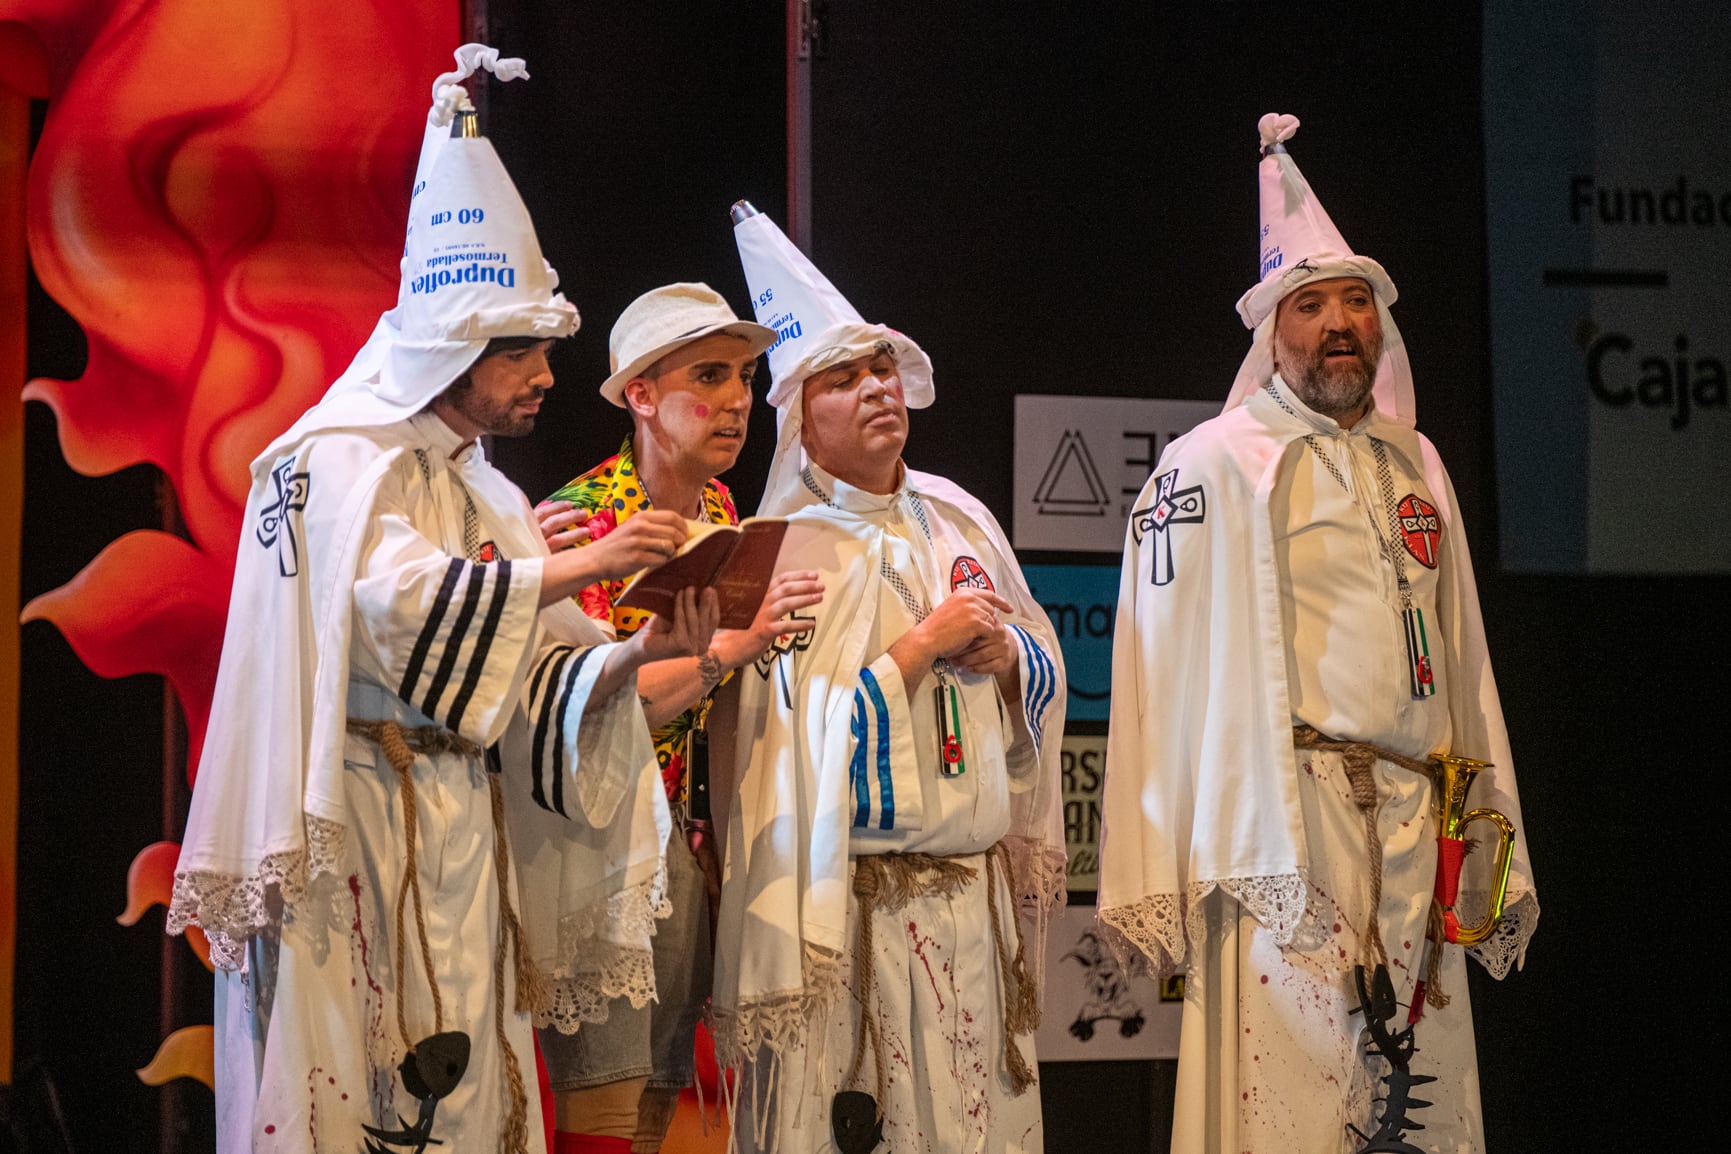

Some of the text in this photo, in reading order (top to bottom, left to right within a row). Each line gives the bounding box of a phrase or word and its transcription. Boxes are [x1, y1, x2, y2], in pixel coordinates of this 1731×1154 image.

[431, 207, 485, 227] 60 cm
[426, 251, 507, 270] Termosellada
[411, 262, 515, 294] Duproflex
[759, 288, 773, 307] 55
[1586, 331, 1729, 432] Caja
[1060, 750, 1106, 794] RS
